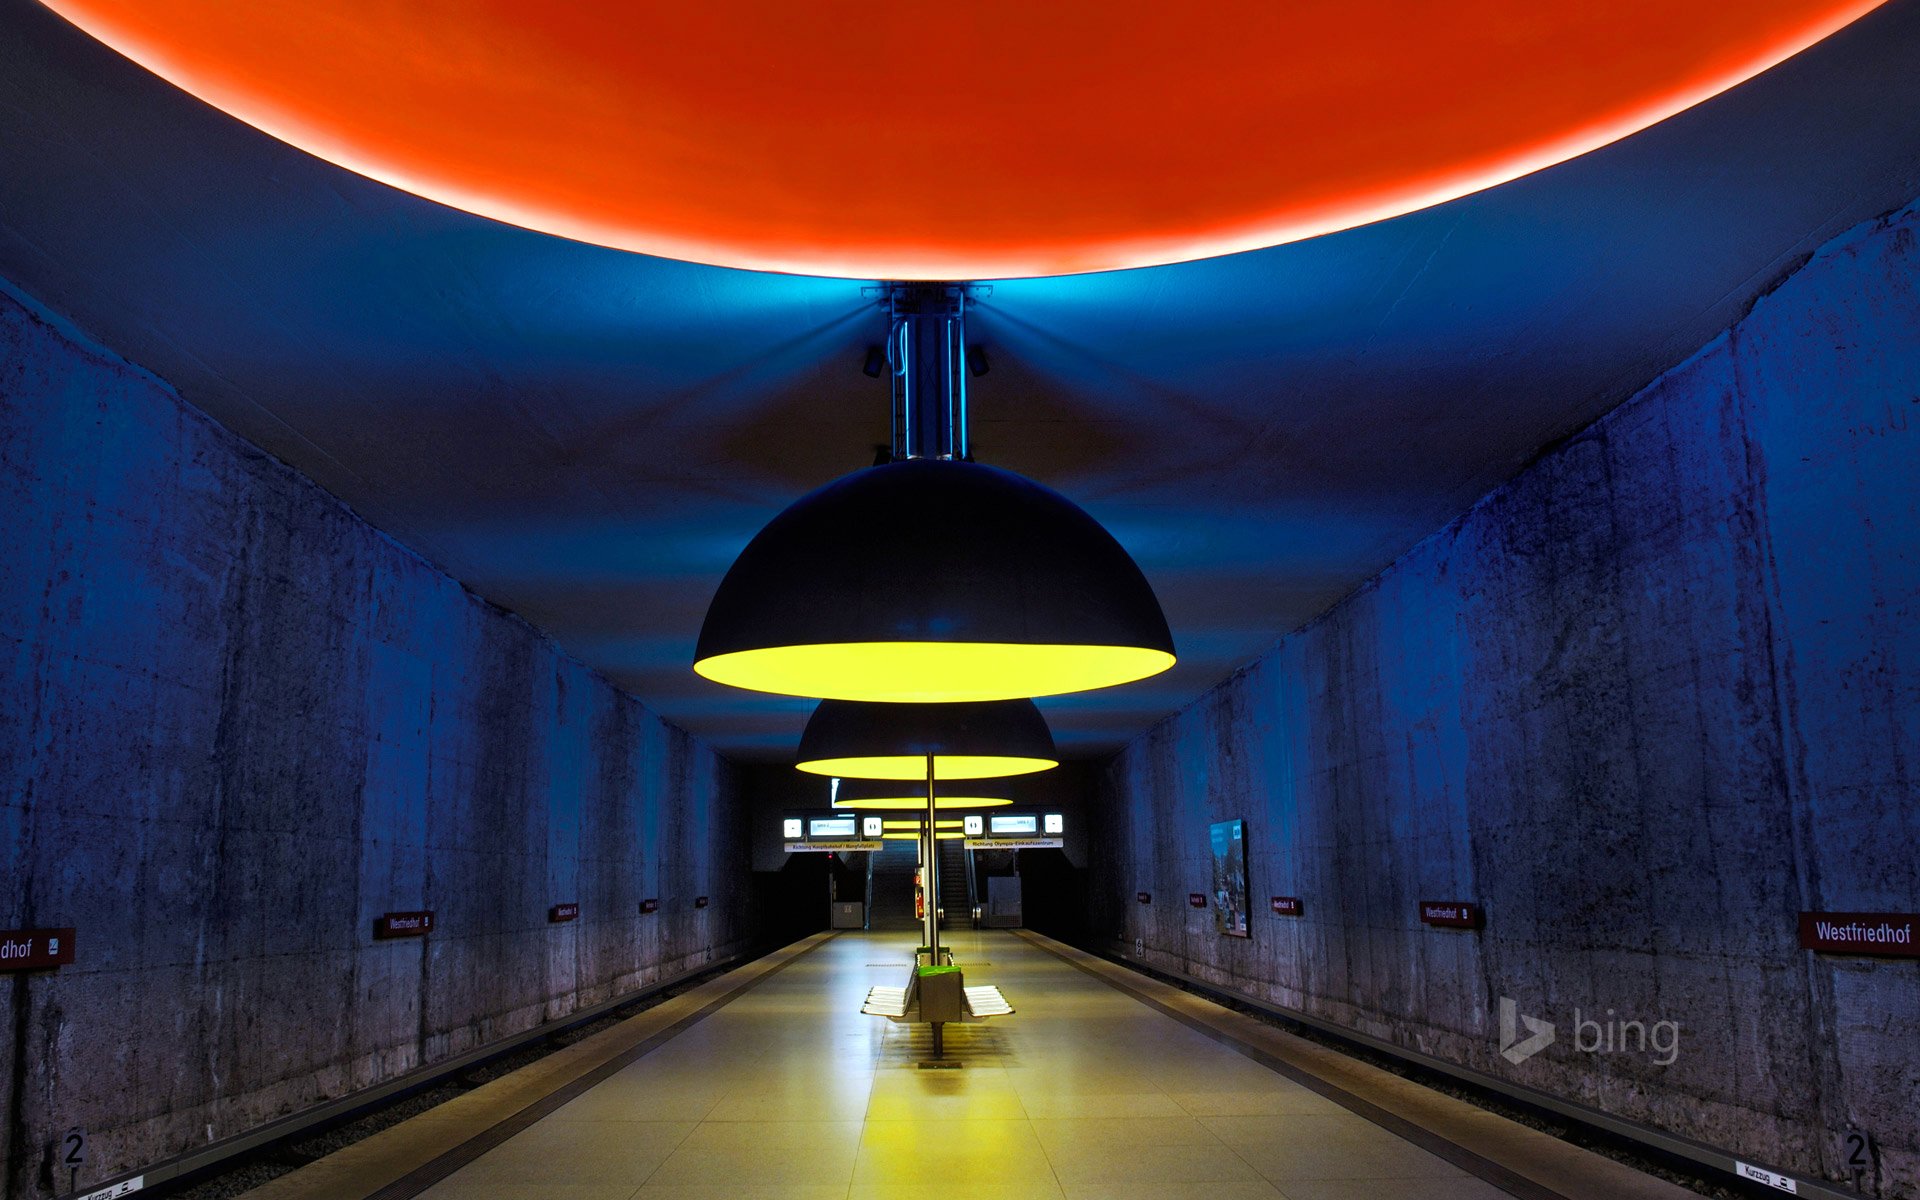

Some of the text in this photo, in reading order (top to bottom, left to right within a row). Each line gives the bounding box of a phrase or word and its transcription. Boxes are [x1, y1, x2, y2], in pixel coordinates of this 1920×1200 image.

[1816, 921, 1910, 943] Westfriedhof
[66, 1134, 83, 1163] 2
[1847, 1134, 1866, 1164] 2
[1745, 1165, 1770, 1184] Kurzzug
